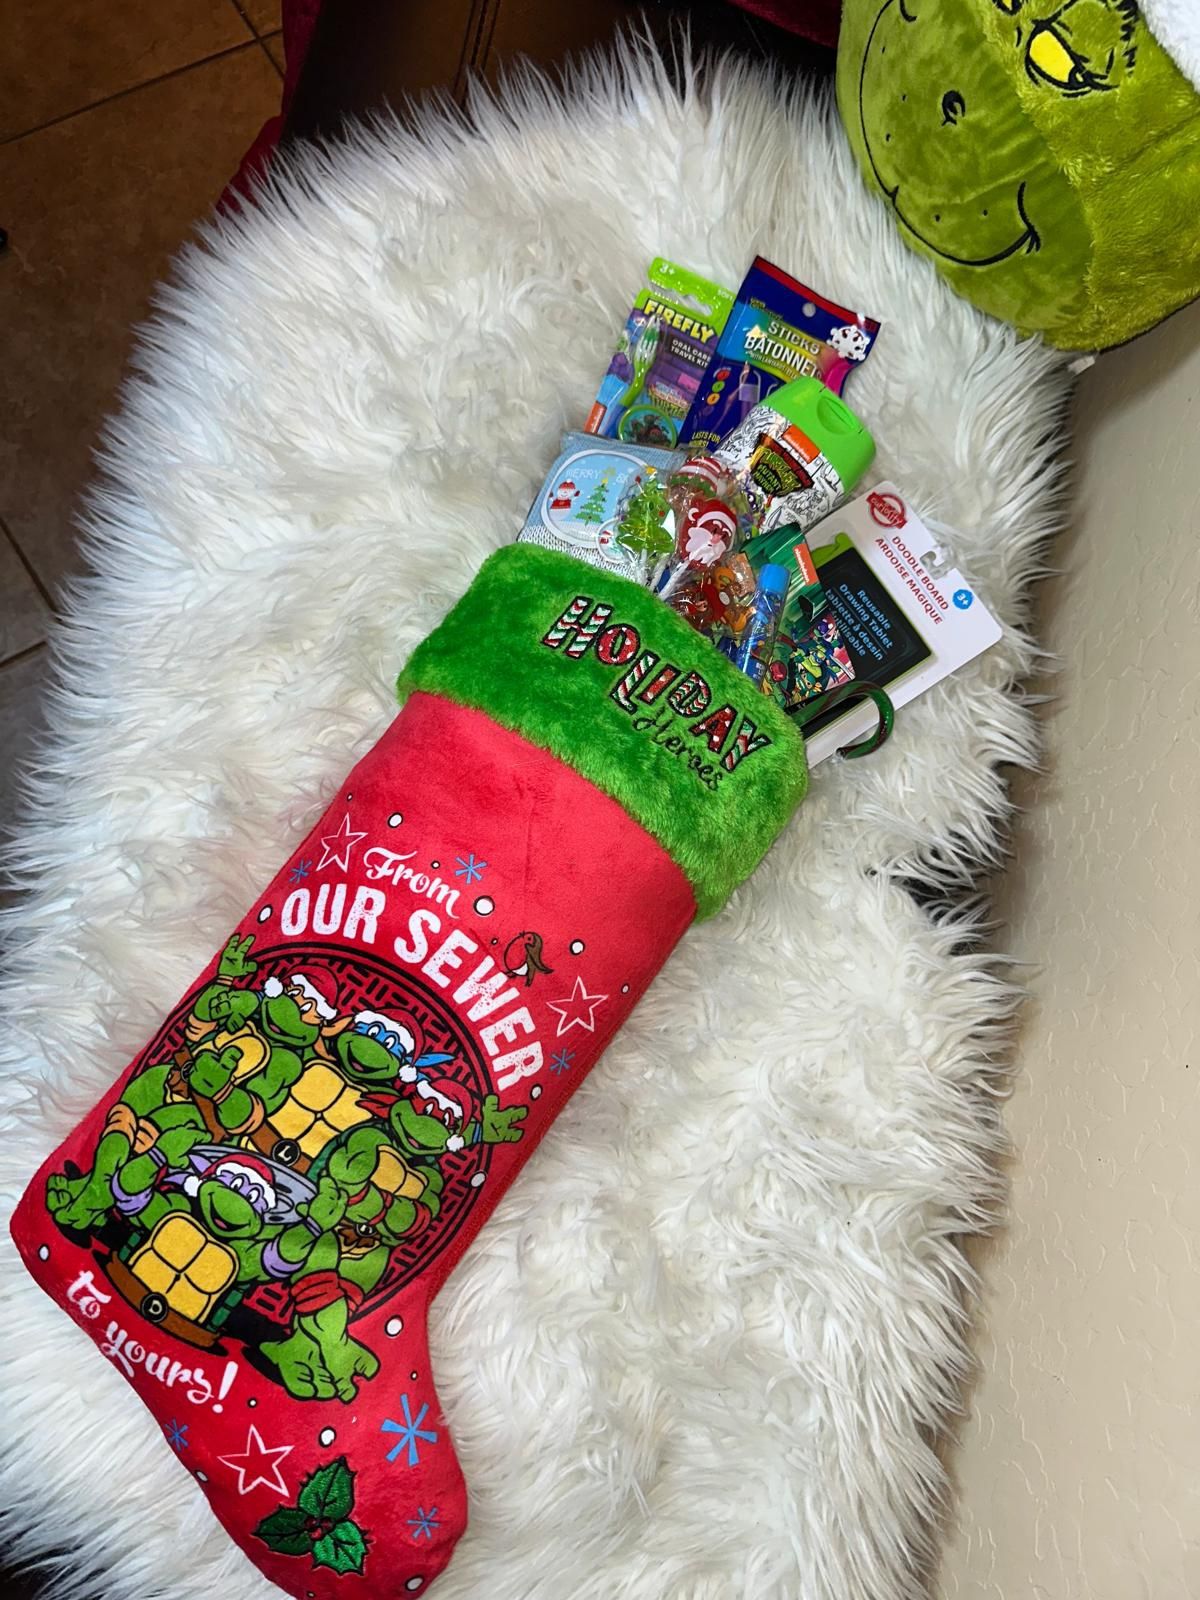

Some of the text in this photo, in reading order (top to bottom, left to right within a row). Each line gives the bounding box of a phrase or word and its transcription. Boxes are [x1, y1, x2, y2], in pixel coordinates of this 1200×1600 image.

[659, 264, 675, 275] 3+
[643, 299, 714, 344] FIREFLY
[768, 321, 820, 355] STICKS
[671, 346, 709, 368] TRAVEL KIT
[672, 339, 691, 353] ORAL
[692, 431, 720, 443] LASTS FOR
[565, 469, 600, 479] MERRY
[758, 463, 781, 490] MUTANT
[875, 538, 943, 624] ARDOISE MAGIQUE
[892, 536, 949, 610] DOODLE BOARD
[840, 584, 893, 649] Drawing Tablet
[857, 590, 891, 630] Reusable
[957, 593, 969, 606] 3+
[825, 589, 883, 660] tablette à dessin
[541, 595, 772, 773] HOLIDAY
[363, 847, 460, 919] From
[281, 883, 544, 1091] OUR SEWER
[66, 1270, 239, 1413] to yours!
